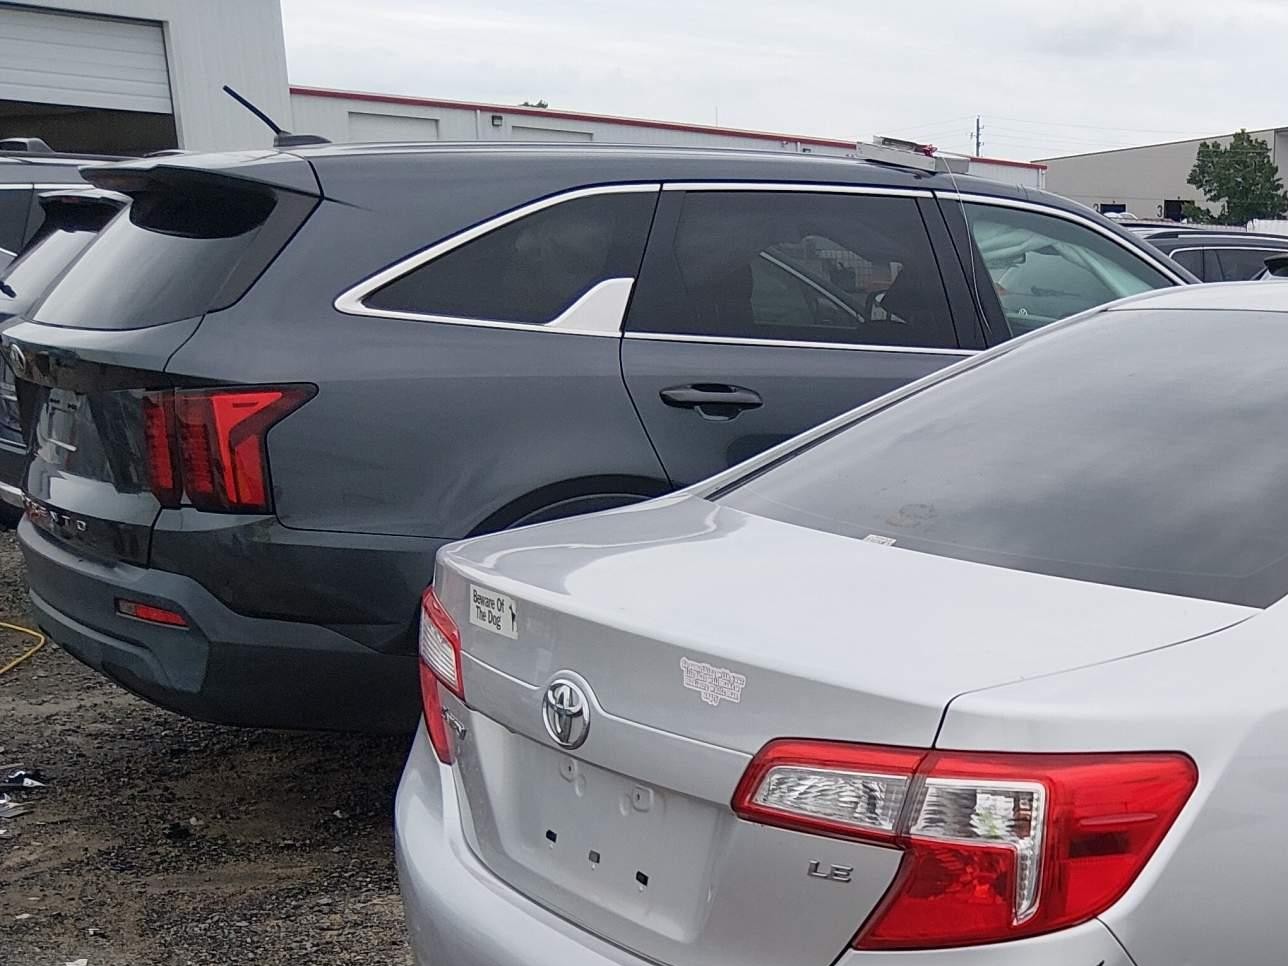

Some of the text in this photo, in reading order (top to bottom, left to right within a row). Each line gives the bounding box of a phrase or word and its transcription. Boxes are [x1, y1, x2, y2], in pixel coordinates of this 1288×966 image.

[1157, 205, 1163, 217] 3
[473, 589, 505, 613] Beware Of
[476, 604, 502, 631] The Dog
[808, 860, 854, 883] LE
